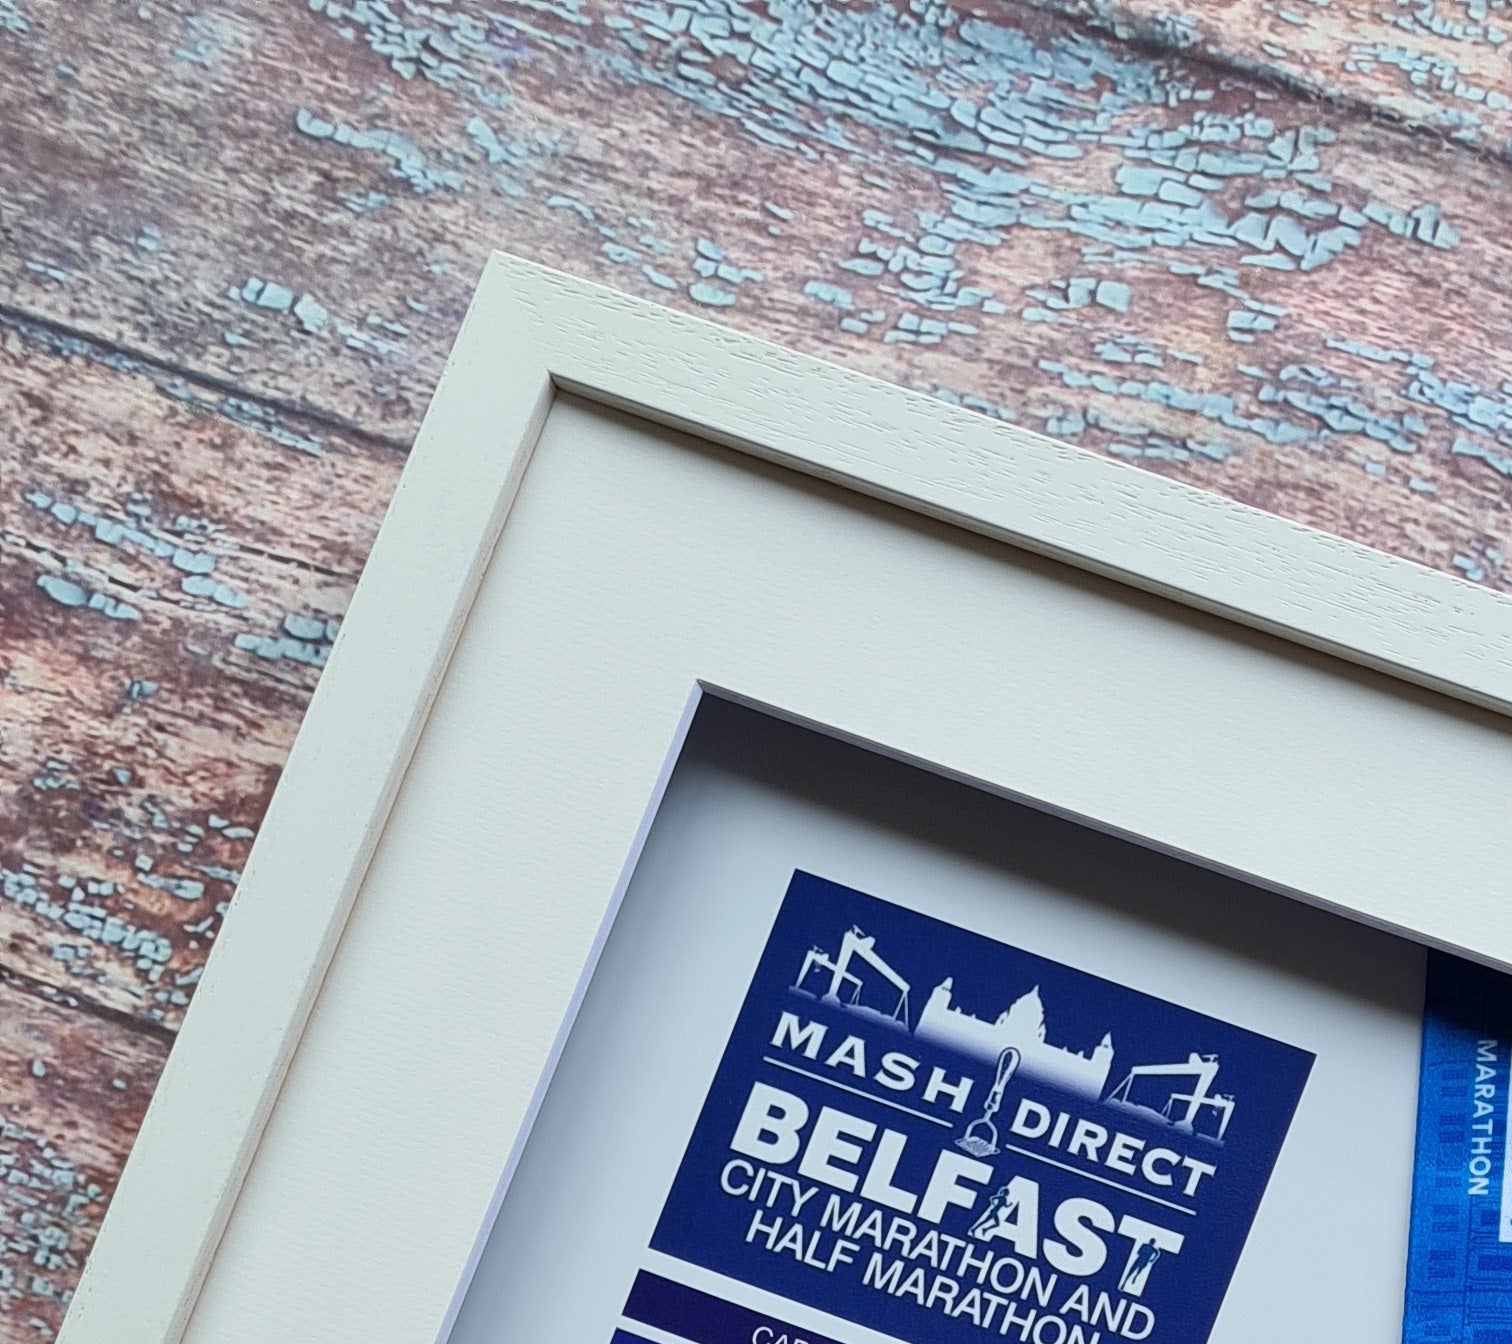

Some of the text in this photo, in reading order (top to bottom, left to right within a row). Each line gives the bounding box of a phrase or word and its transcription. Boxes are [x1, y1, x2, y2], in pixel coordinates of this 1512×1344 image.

[730, 1081, 1185, 1296] BELFAST
[770, 1011, 1216, 1198] MASH DIRECT
[1468, 1039, 1499, 1196] MARATHON
[720, 1159, 1156, 1341] CITY MARATHON AND
[745, 1209, 860, 1272] HALF
